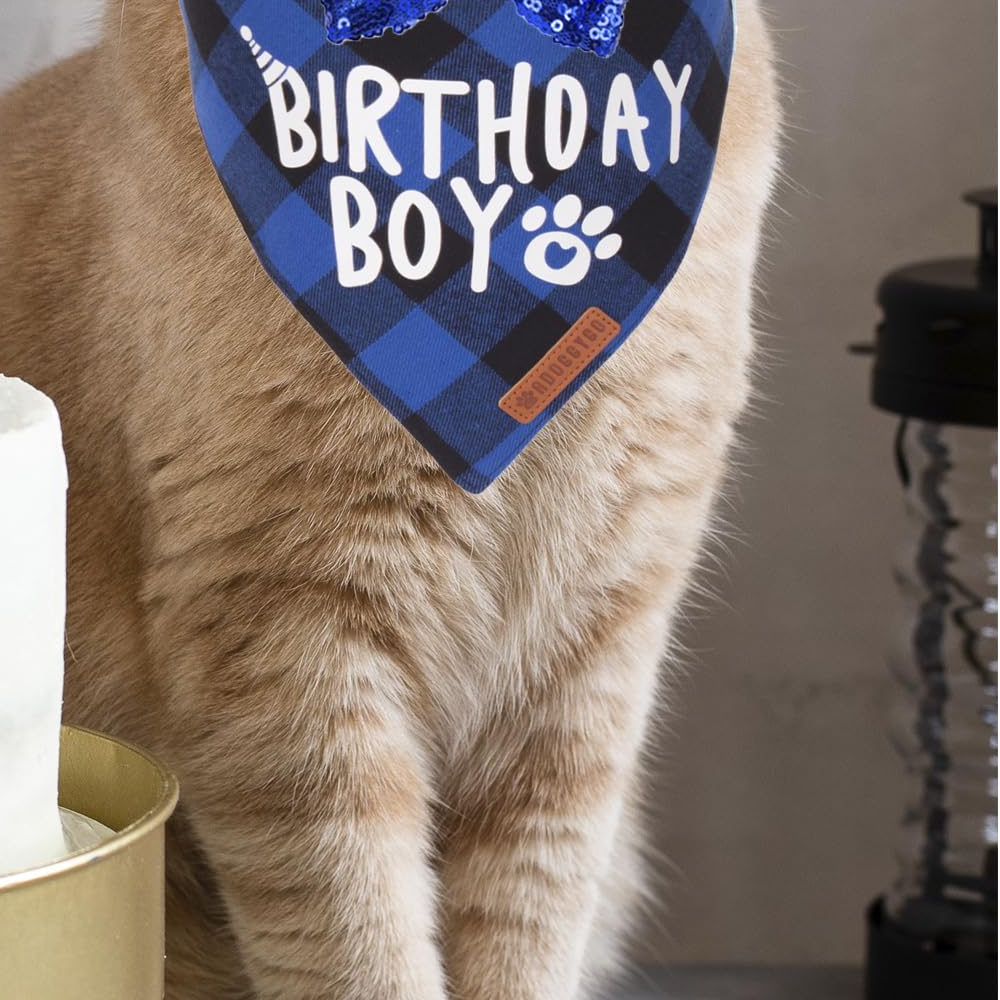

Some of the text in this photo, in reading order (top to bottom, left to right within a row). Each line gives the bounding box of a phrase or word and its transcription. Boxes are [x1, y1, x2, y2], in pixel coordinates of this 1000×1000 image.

[268, 60, 692, 184] BIRTHDAY
[330, 175, 513, 292] BOY
[531, 319, 606, 395] ADOGGYGO
